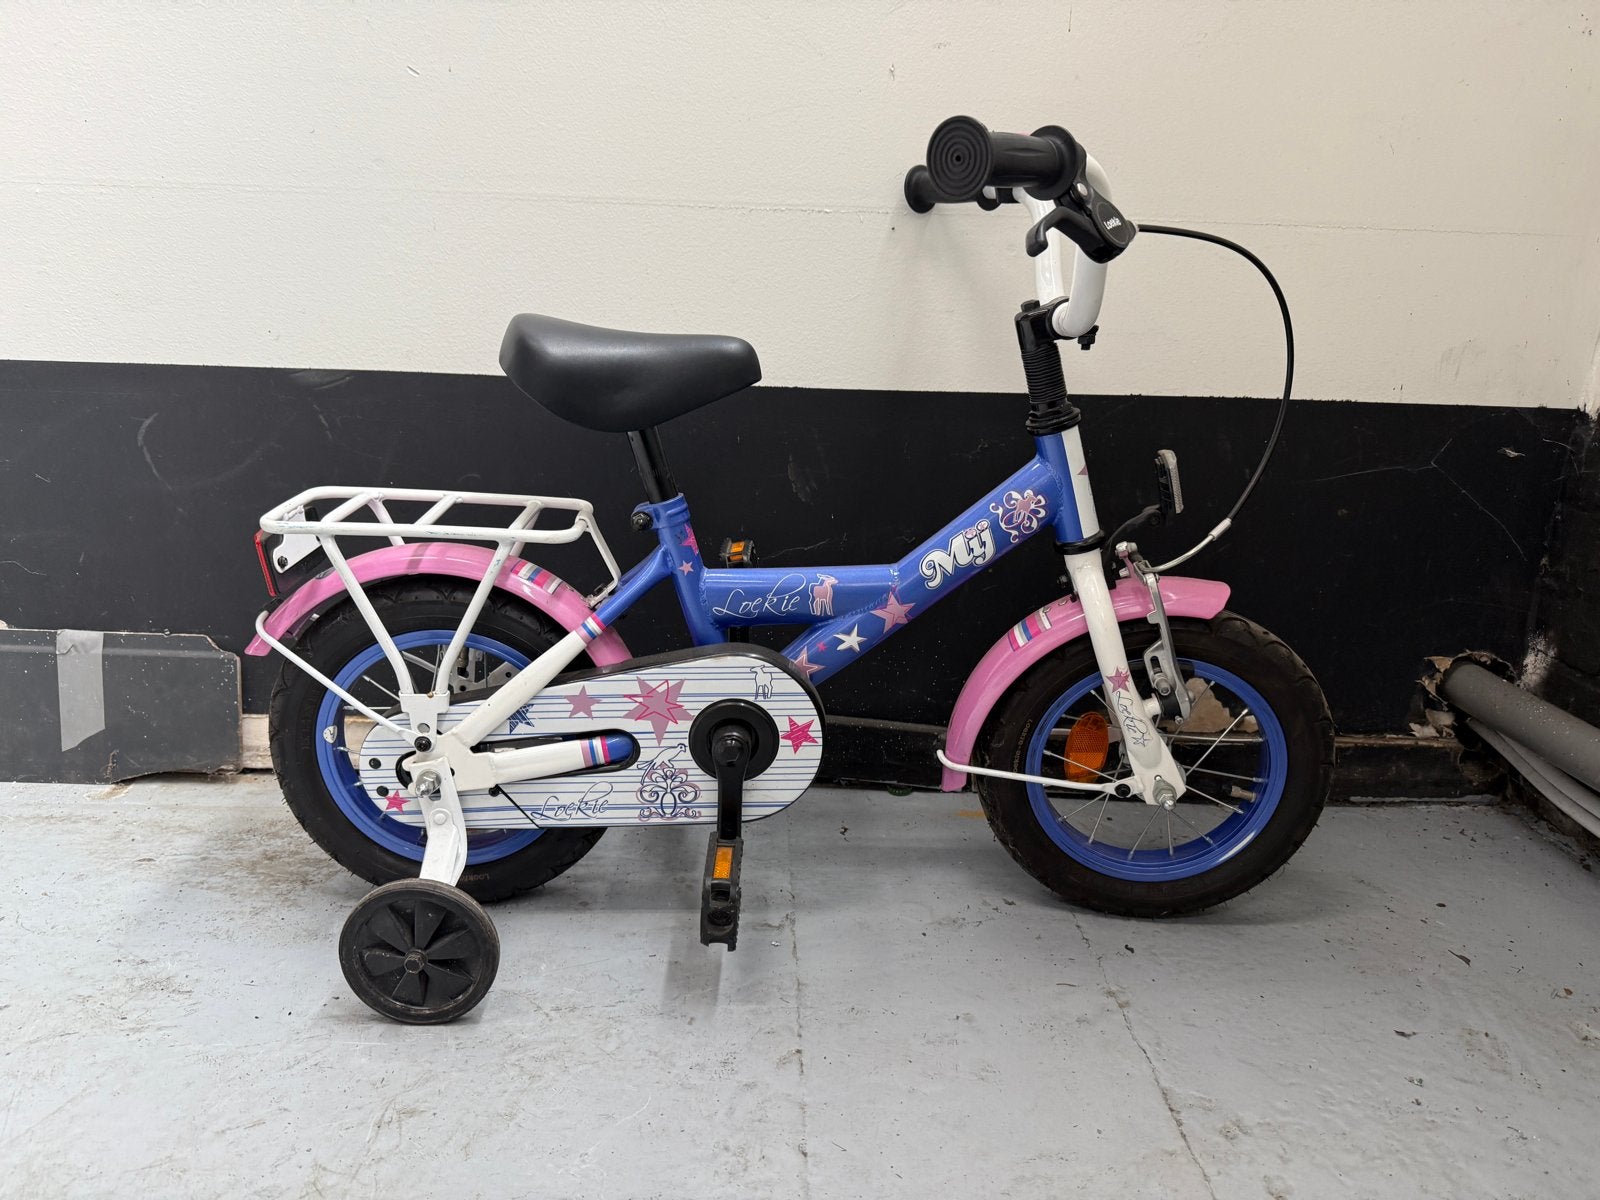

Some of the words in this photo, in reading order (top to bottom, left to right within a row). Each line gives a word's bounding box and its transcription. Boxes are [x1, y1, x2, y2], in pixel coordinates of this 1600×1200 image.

[919, 518, 996, 590] Mij
[712, 573, 807, 619] Loekie
[530, 780, 614, 821] Loekie
